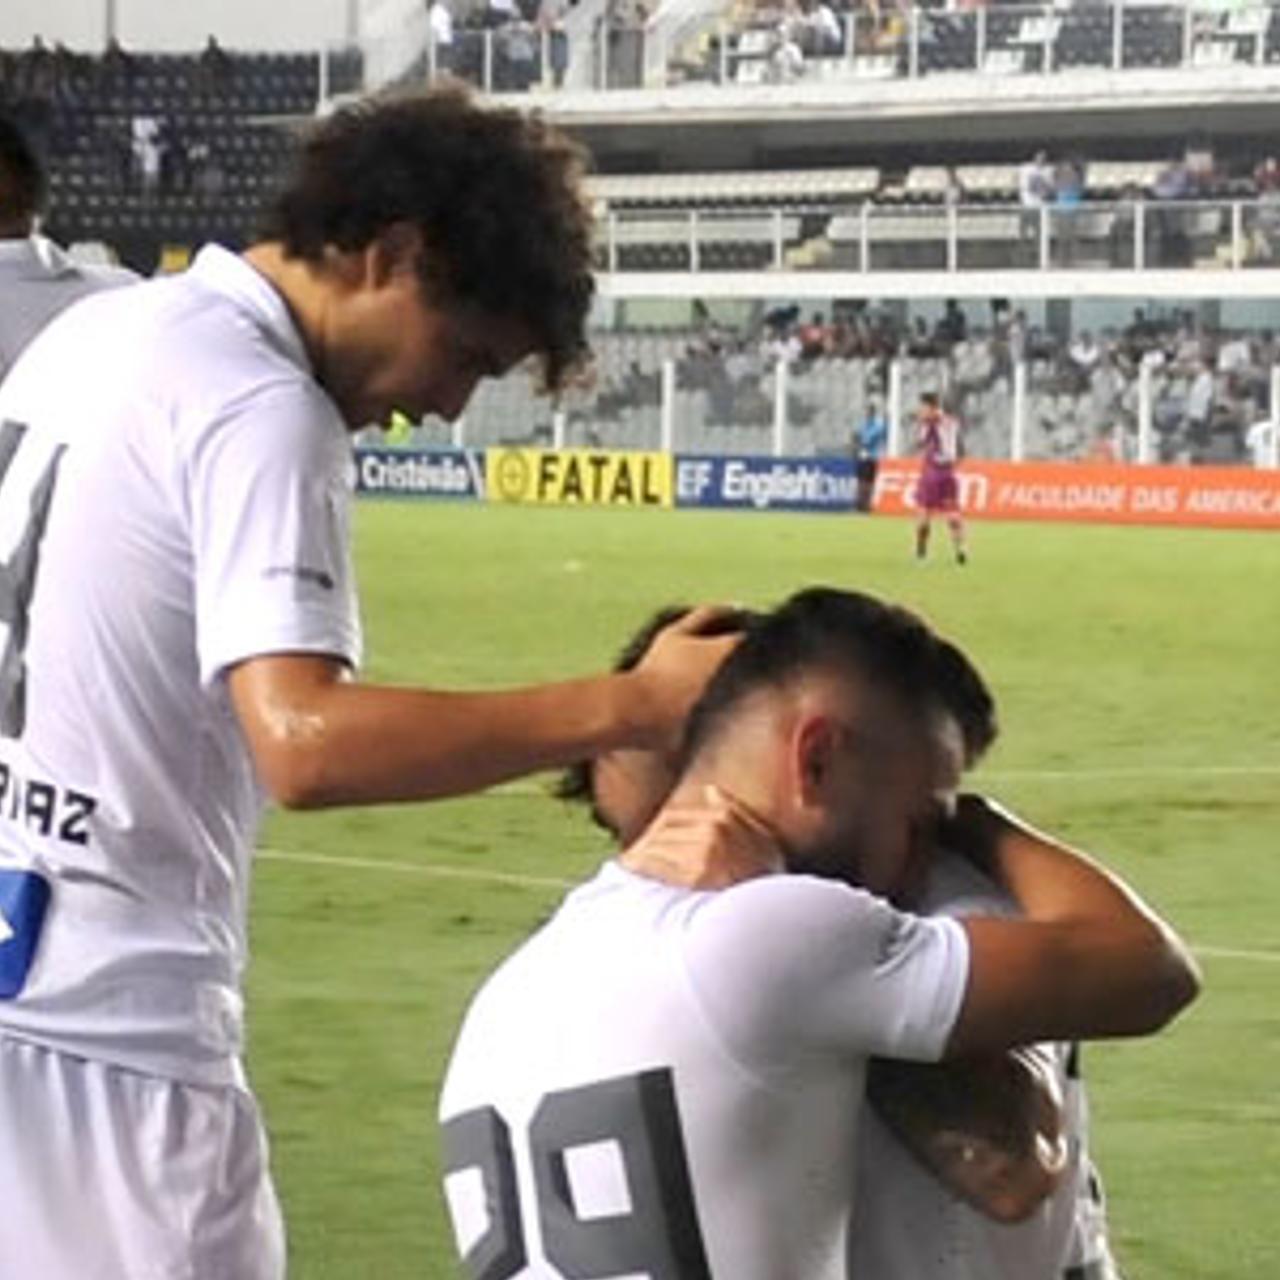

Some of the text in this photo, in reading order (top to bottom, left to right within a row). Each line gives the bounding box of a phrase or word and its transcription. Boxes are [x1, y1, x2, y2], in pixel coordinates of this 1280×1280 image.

[538, 455, 660, 504] FATAL
[677, 461, 711, 496] EF
[1131, 485, 1179, 513] DAS
